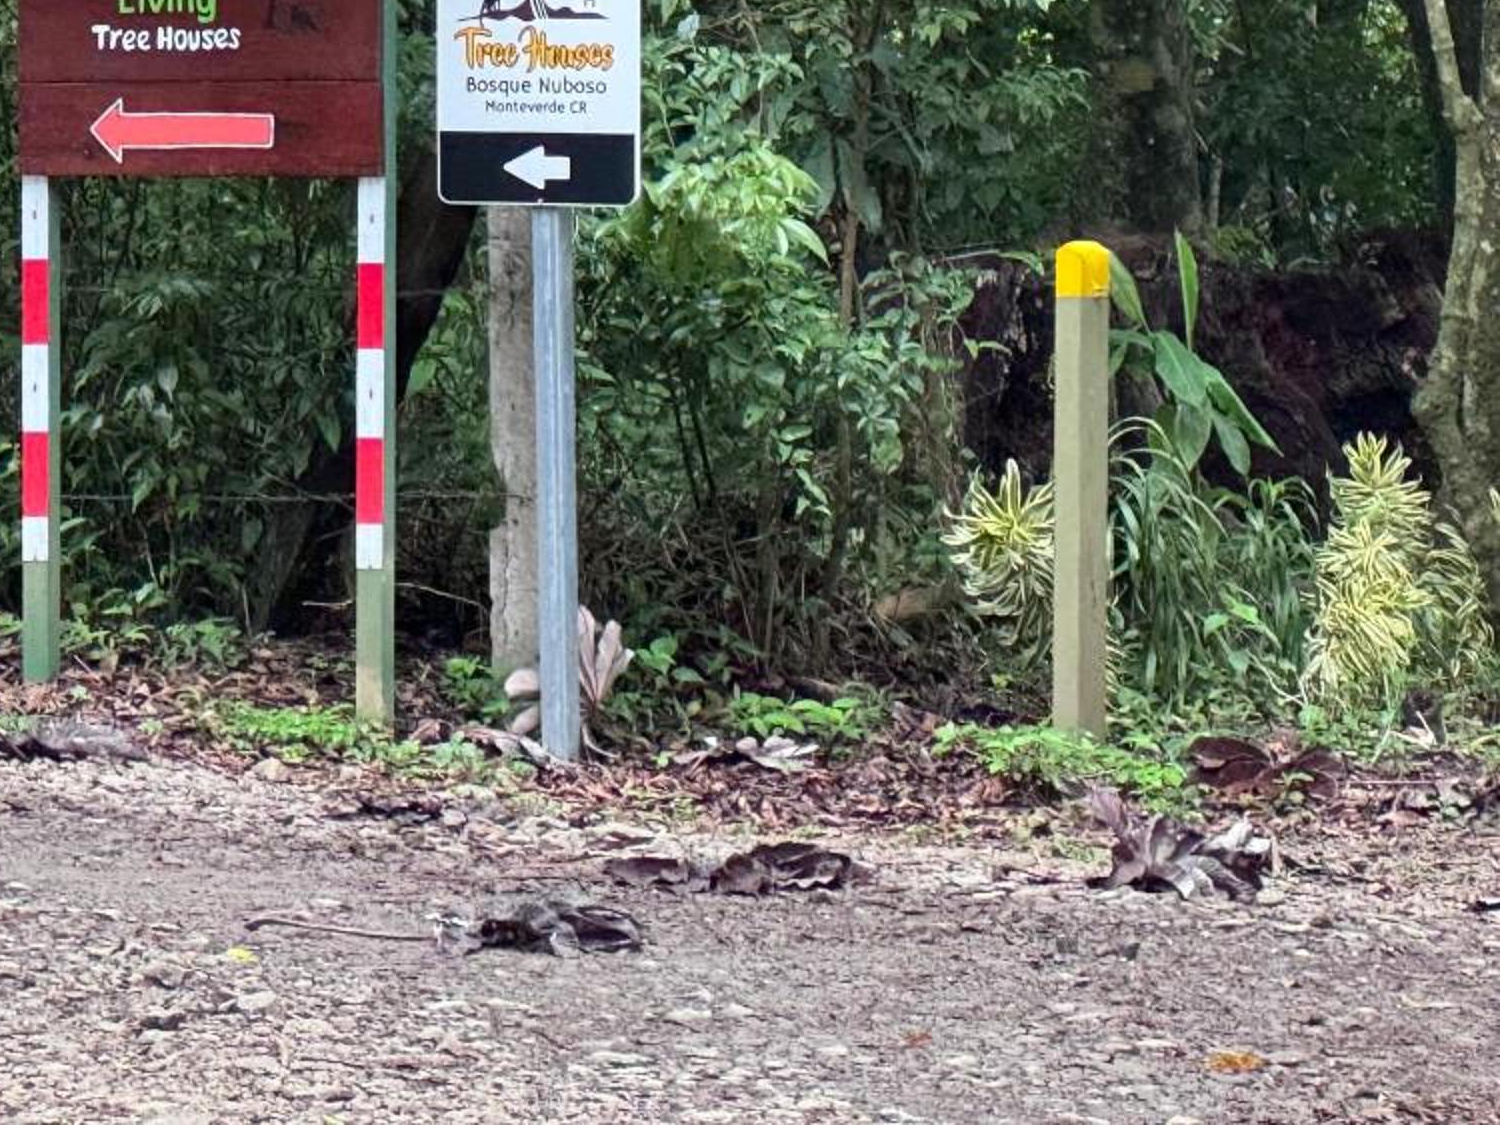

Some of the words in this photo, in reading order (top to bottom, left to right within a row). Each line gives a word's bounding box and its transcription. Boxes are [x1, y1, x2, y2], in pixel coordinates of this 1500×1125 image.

[91, 24, 151, 51] Tree
[156, 24, 241, 52] Houses
[453, 26, 519, 70] Tree
[517, 25, 615, 73] Houses
[466, 76, 531, 97] Bosque
[539, 75, 607, 95] Nuboso
[485, 100, 565, 114] Monteverde
[569, 100, 587, 114] CR
